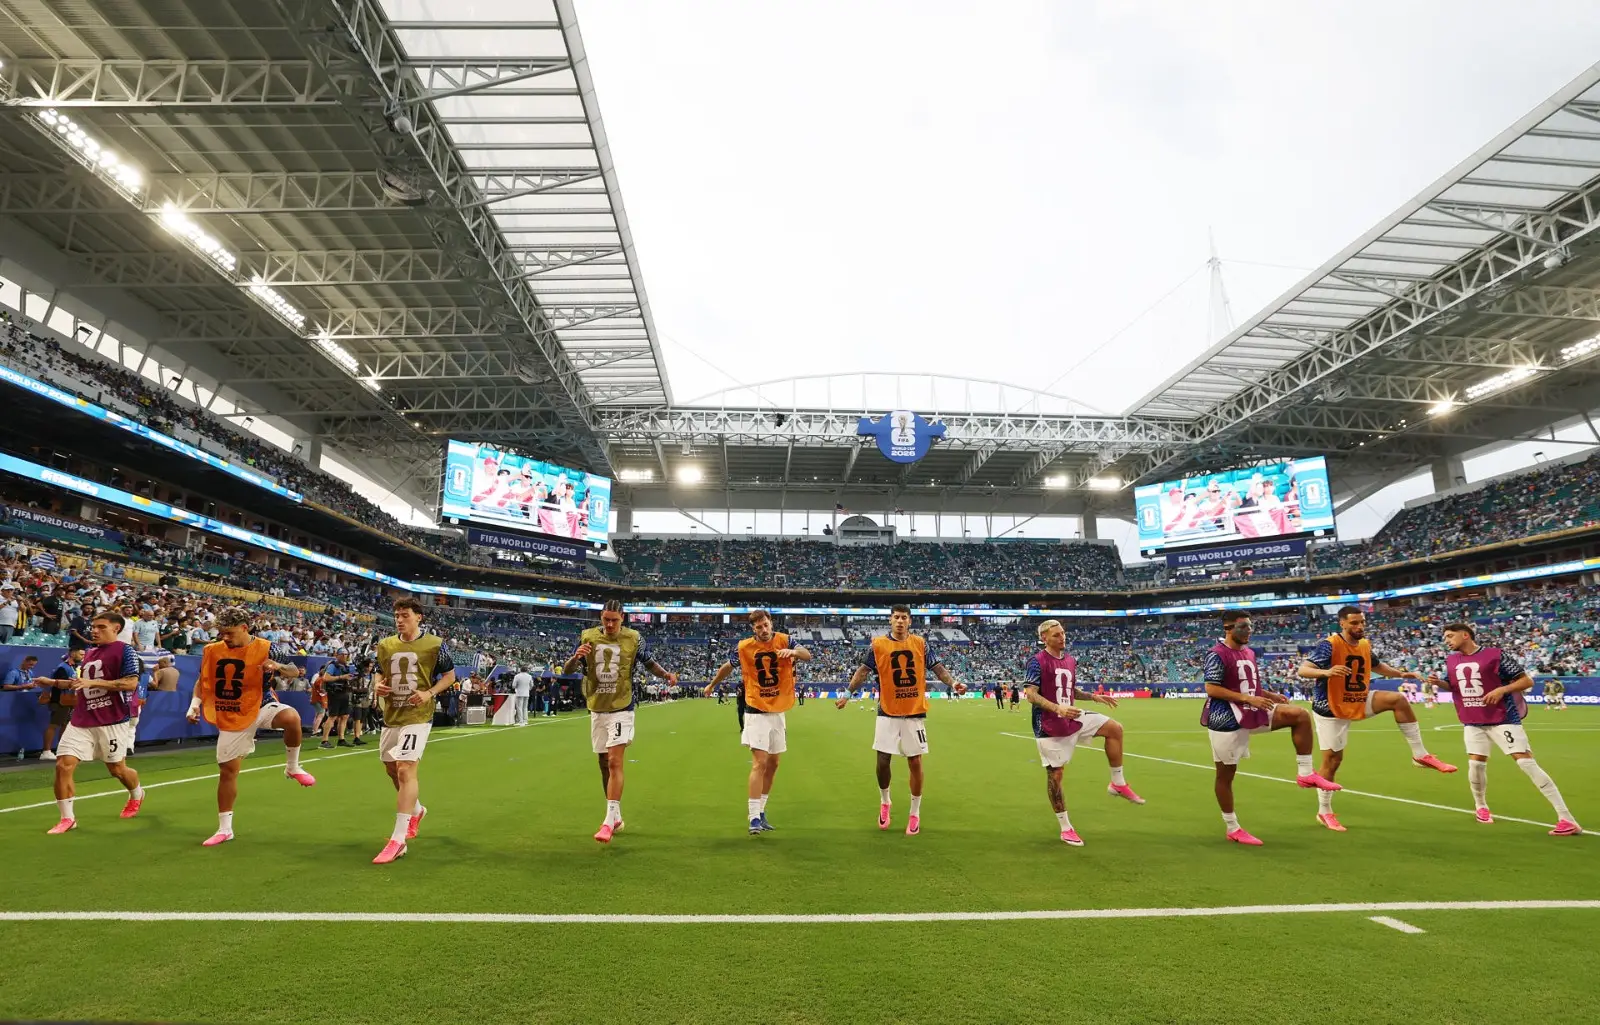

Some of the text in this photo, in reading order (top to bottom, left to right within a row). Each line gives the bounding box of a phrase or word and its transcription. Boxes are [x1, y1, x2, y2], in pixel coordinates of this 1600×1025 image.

[12, 508, 31, 520] FIFA
[33, 513, 62, 527] WORLD
[63, 521, 79, 530] CUP
[480, 534, 577, 556] FIFA WORLD CUP 2026
[1178, 544, 1291, 563] FIFA WORLD CUP 2026
[1563, 695, 1598, 703] 2026
[401, 734, 418, 751] 21
[1503, 730, 1514, 743] 8
[109, 739, 118, 753] 5
